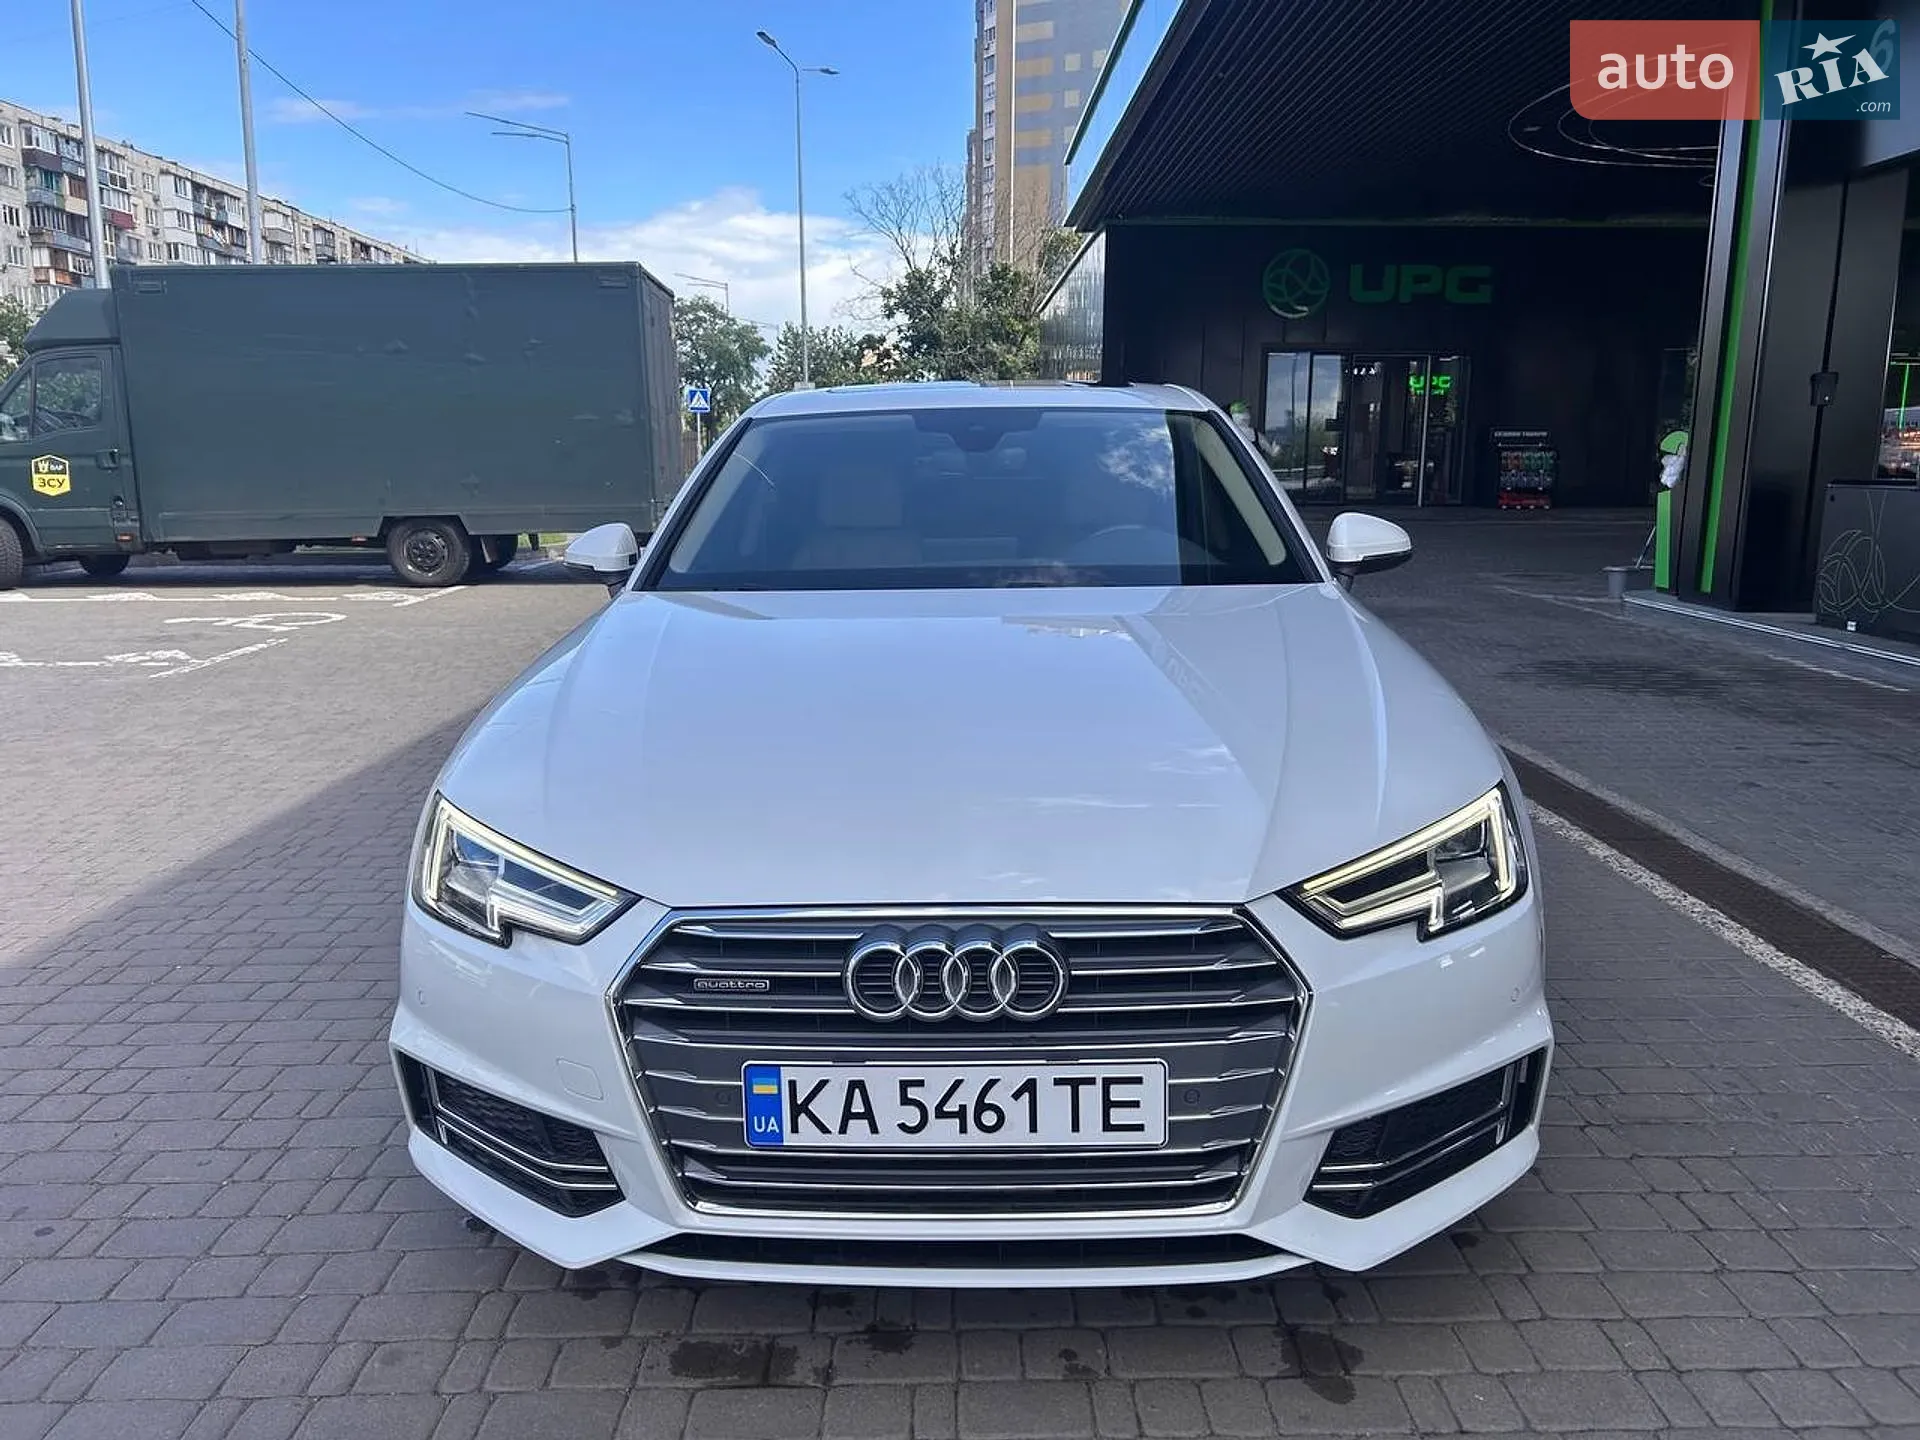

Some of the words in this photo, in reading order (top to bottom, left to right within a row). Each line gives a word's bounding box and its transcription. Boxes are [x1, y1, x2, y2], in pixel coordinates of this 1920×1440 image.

[1350, 264, 1492, 303] UPG
[697, 981, 766, 989] quattro
[787, 1078, 880, 1135] KA
[896, 1077, 1038, 1135] 5461
[1053, 1075, 1146, 1132] TE
[753, 1117, 779, 1134] UA
